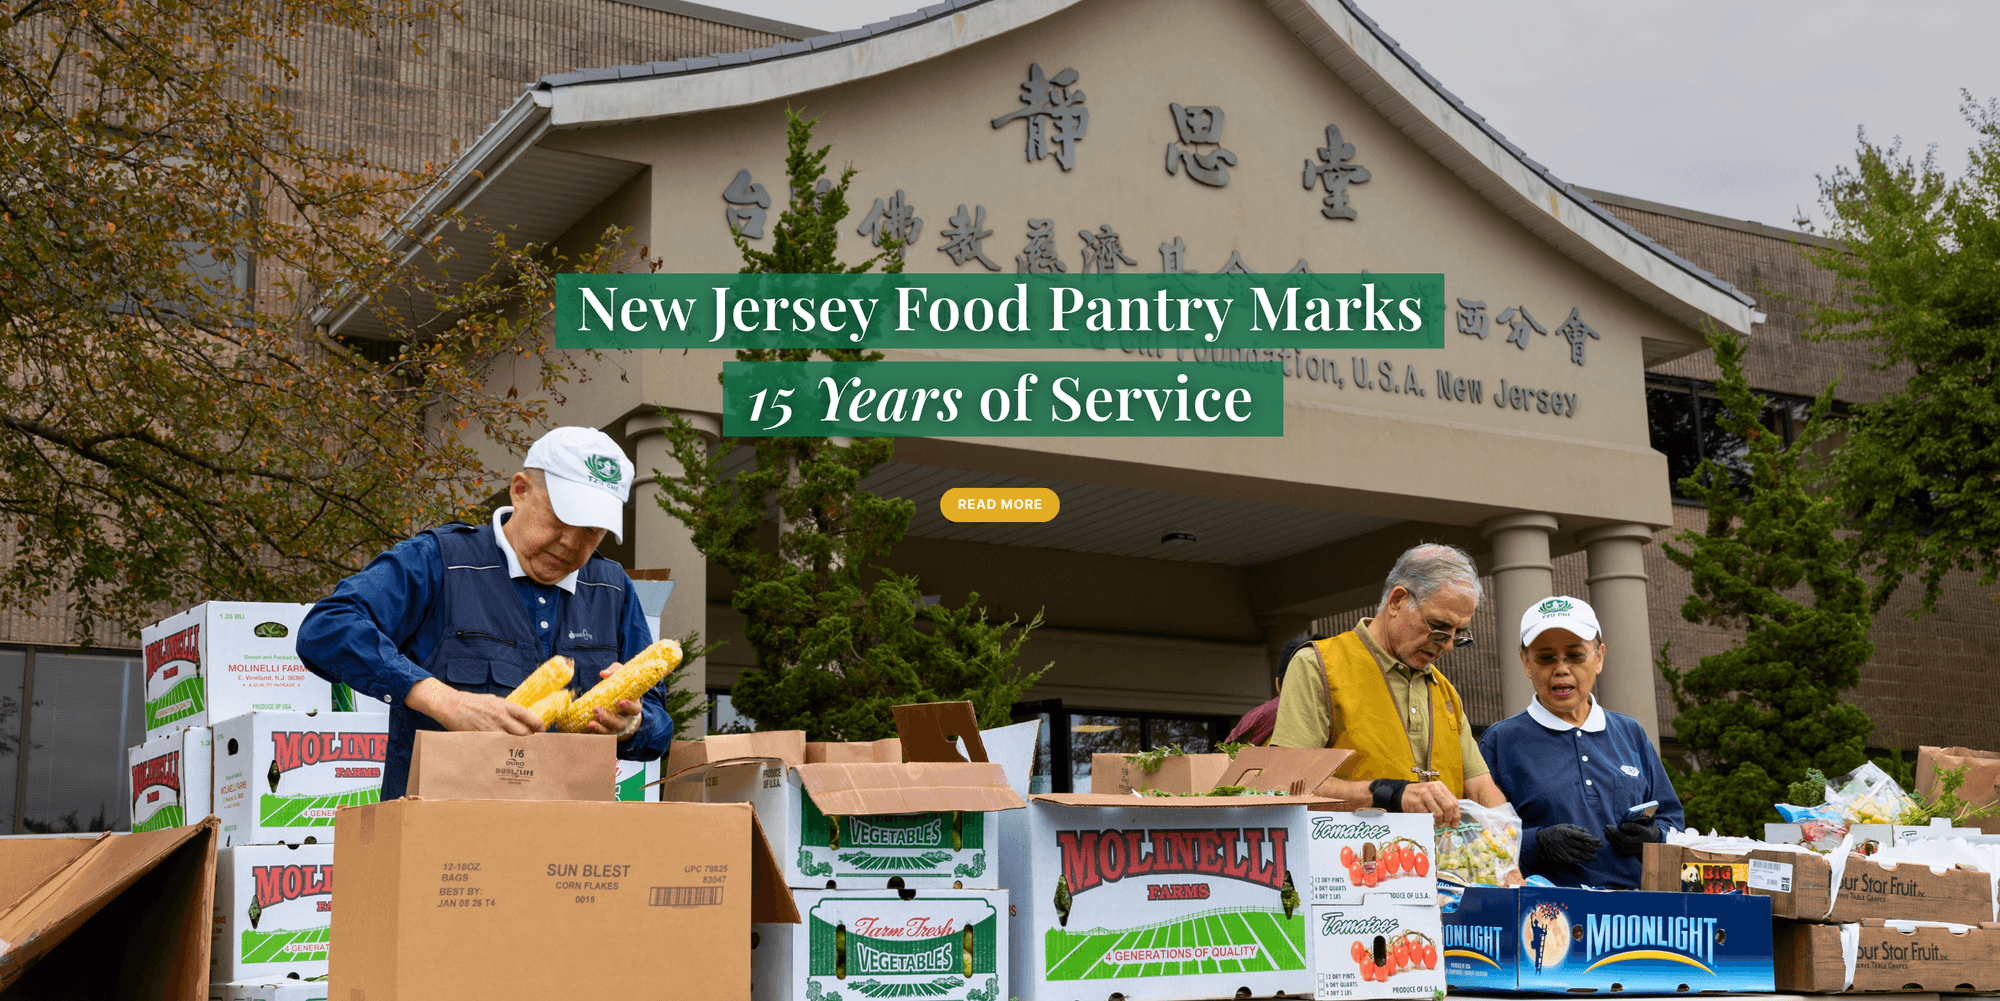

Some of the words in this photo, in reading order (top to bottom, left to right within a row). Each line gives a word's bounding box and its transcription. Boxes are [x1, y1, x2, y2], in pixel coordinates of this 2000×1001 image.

[1352, 356, 1427, 397] U.S.A.
[1437, 368, 1483, 404] New
[1494, 378, 1578, 418] Jersey
[228, 664, 280, 673] MOLINELLI
[508, 748, 525, 758] 1/6
[335, 766, 381, 778] FARMS
[763, 768, 782, 779] PRODUCE
[763, 780, 770, 789] OF
[850, 815, 941, 845] VEGETABLES
[1311, 816, 1390, 840] Tomatoes
[684, 865, 702, 873] UPC
[704, 864, 728, 873] 79825
[1056, 827, 1290, 897] MOLINELLI
[441, 873, 469, 882] BAGS
[546, 863, 578, 877] SUN
[582, 864, 631, 878] BLEST
[1703, 865, 1733, 880] BIG
[555, 881, 582, 890] CORN
[584, 881, 619, 890] FLAKES
[702, 875, 727, 884] 83047
[1861, 873, 1888, 894] Star
[439, 887, 465, 896] BEST
[467, 887, 483, 896] BY:
[1147, 883, 1211, 901] FARMS
[437, 899, 457, 908] JAN
[458, 899, 470, 907] 08
[472, 899, 483, 907] 26
[484, 899, 496, 907] T4
[575, 895, 596, 904] 0015
[854, 917, 904, 937] Farm
[906, 917, 956, 937] Fresh
[1321, 912, 1399, 936] Tomatoes
[1586, 913, 1718, 969] MOONLIGHT
[857, 942, 952, 972] VEGETABLES
[1105, 950, 1112, 962] 4
[1114, 948, 1193, 961] GENERATIONS
[1194, 947, 1209, 959] OF
[1211, 945, 1256, 959] QUALITY
[1857, 945, 1879, 960] our
[1881, 941, 1908, 960] Star
